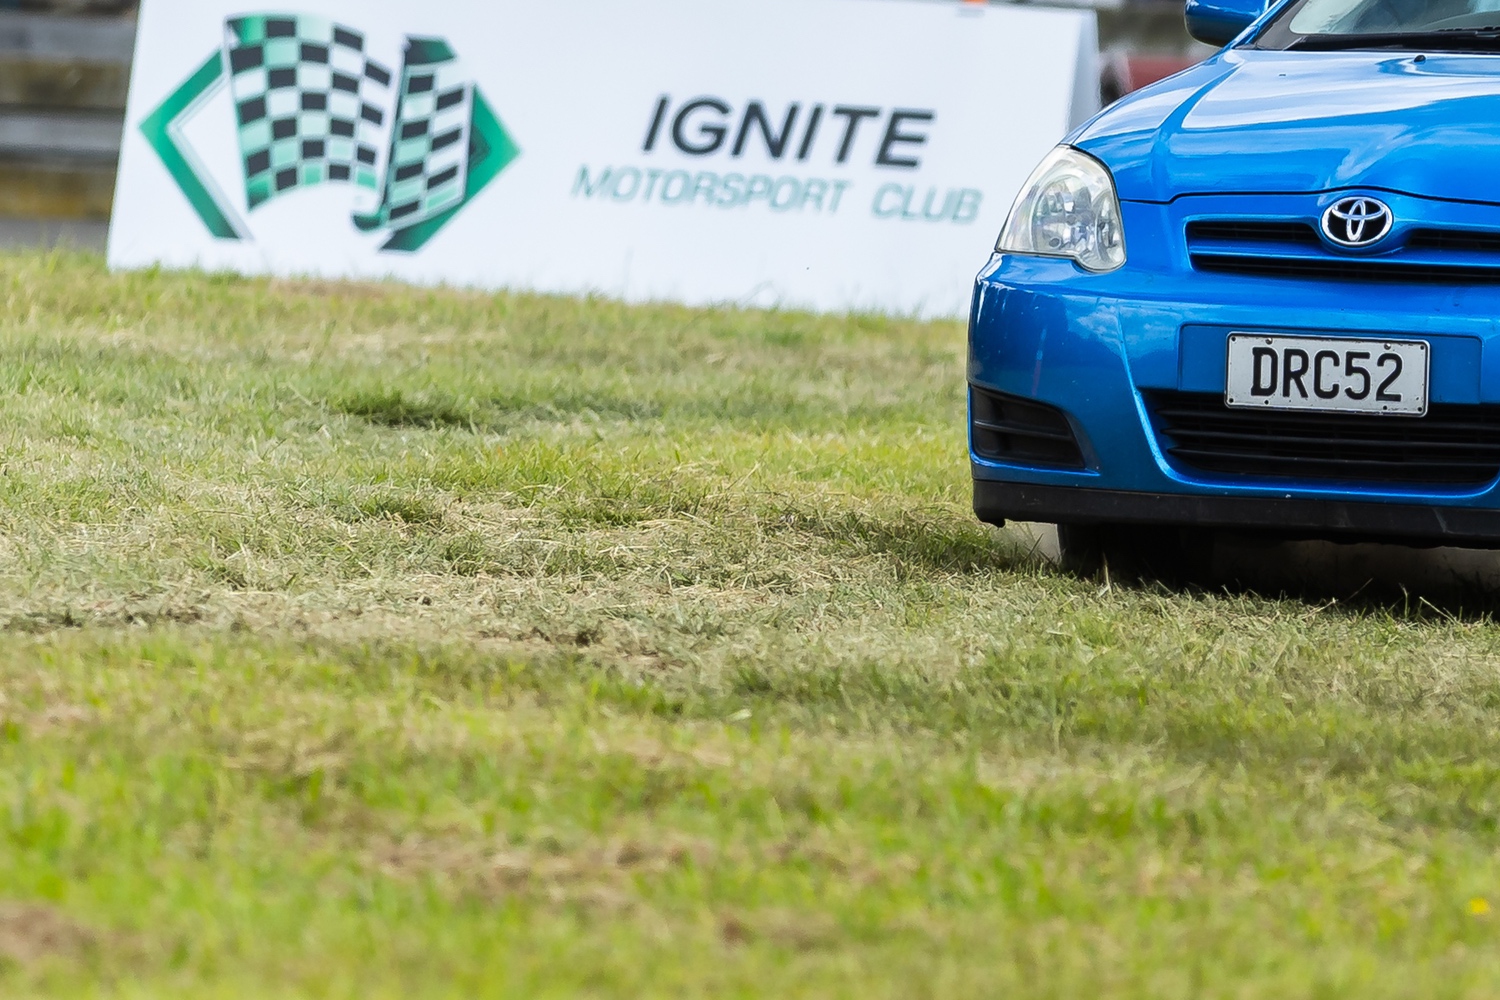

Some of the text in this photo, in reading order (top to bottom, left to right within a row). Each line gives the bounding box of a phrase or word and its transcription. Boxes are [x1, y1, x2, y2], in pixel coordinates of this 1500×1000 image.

[641, 94, 935, 168] IGNITE
[571, 164, 984, 224] MOTORSPORT CLUB
[1250, 346, 1404, 403] DRC52
